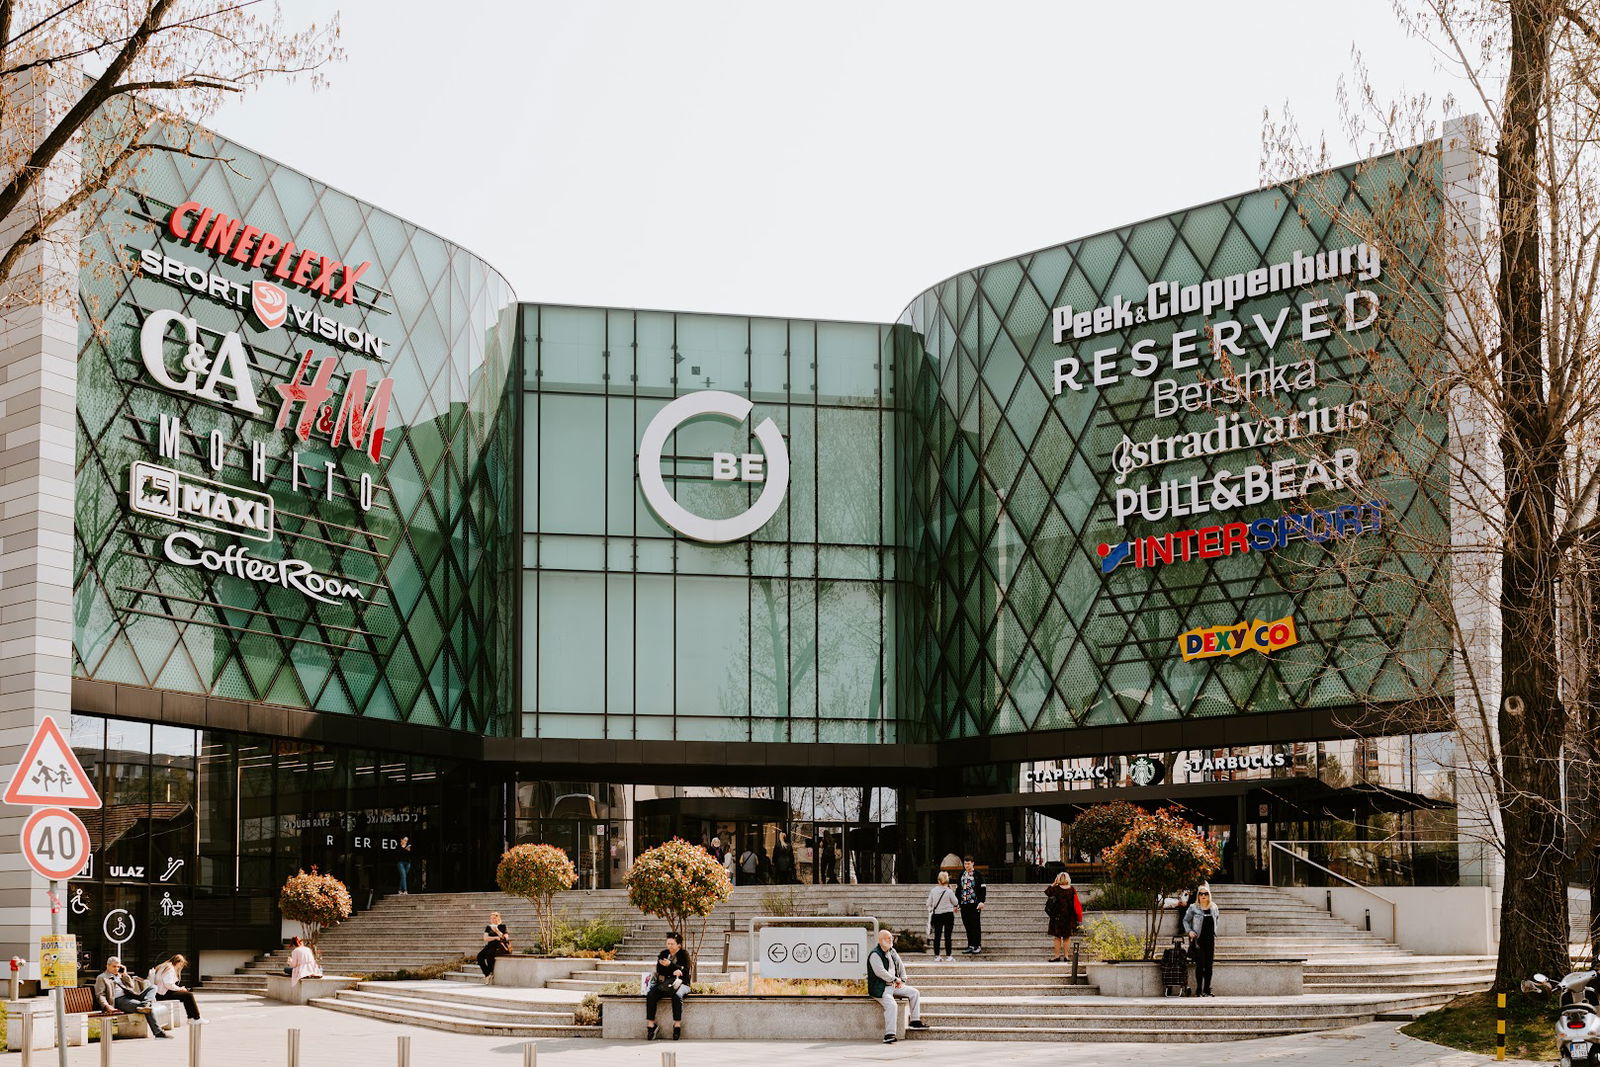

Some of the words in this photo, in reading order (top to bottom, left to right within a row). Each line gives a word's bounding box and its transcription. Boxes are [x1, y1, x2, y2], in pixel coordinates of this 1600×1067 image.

[169, 202, 372, 305] CINEPLEXX
[140, 249, 249, 306] SPORT
[291, 305, 383, 358] VISION
[140, 309, 263, 415] C&A
[1053, 289, 1381, 396] RESERVED
[275, 349, 394, 464] H&M
[1153, 356, 1316, 419] Bershka
[159, 413, 372, 511] MOHITO
[713, 452, 764, 482] BE
[1116, 448, 1365, 526] PULL&BEAR
[182, 484, 268, 530] MAXI
[1135, 498, 1388, 569] INTERSPORT
[1187, 628, 1247, 656] DEXY
[1255, 623, 1290, 647] CO
[1026, 766, 1105, 782] СТАРБАКС
[1183, 753, 1286, 772] STARBUCKS
[37, 826, 76, 860] 40
[110, 866, 144, 878] ULAZ
